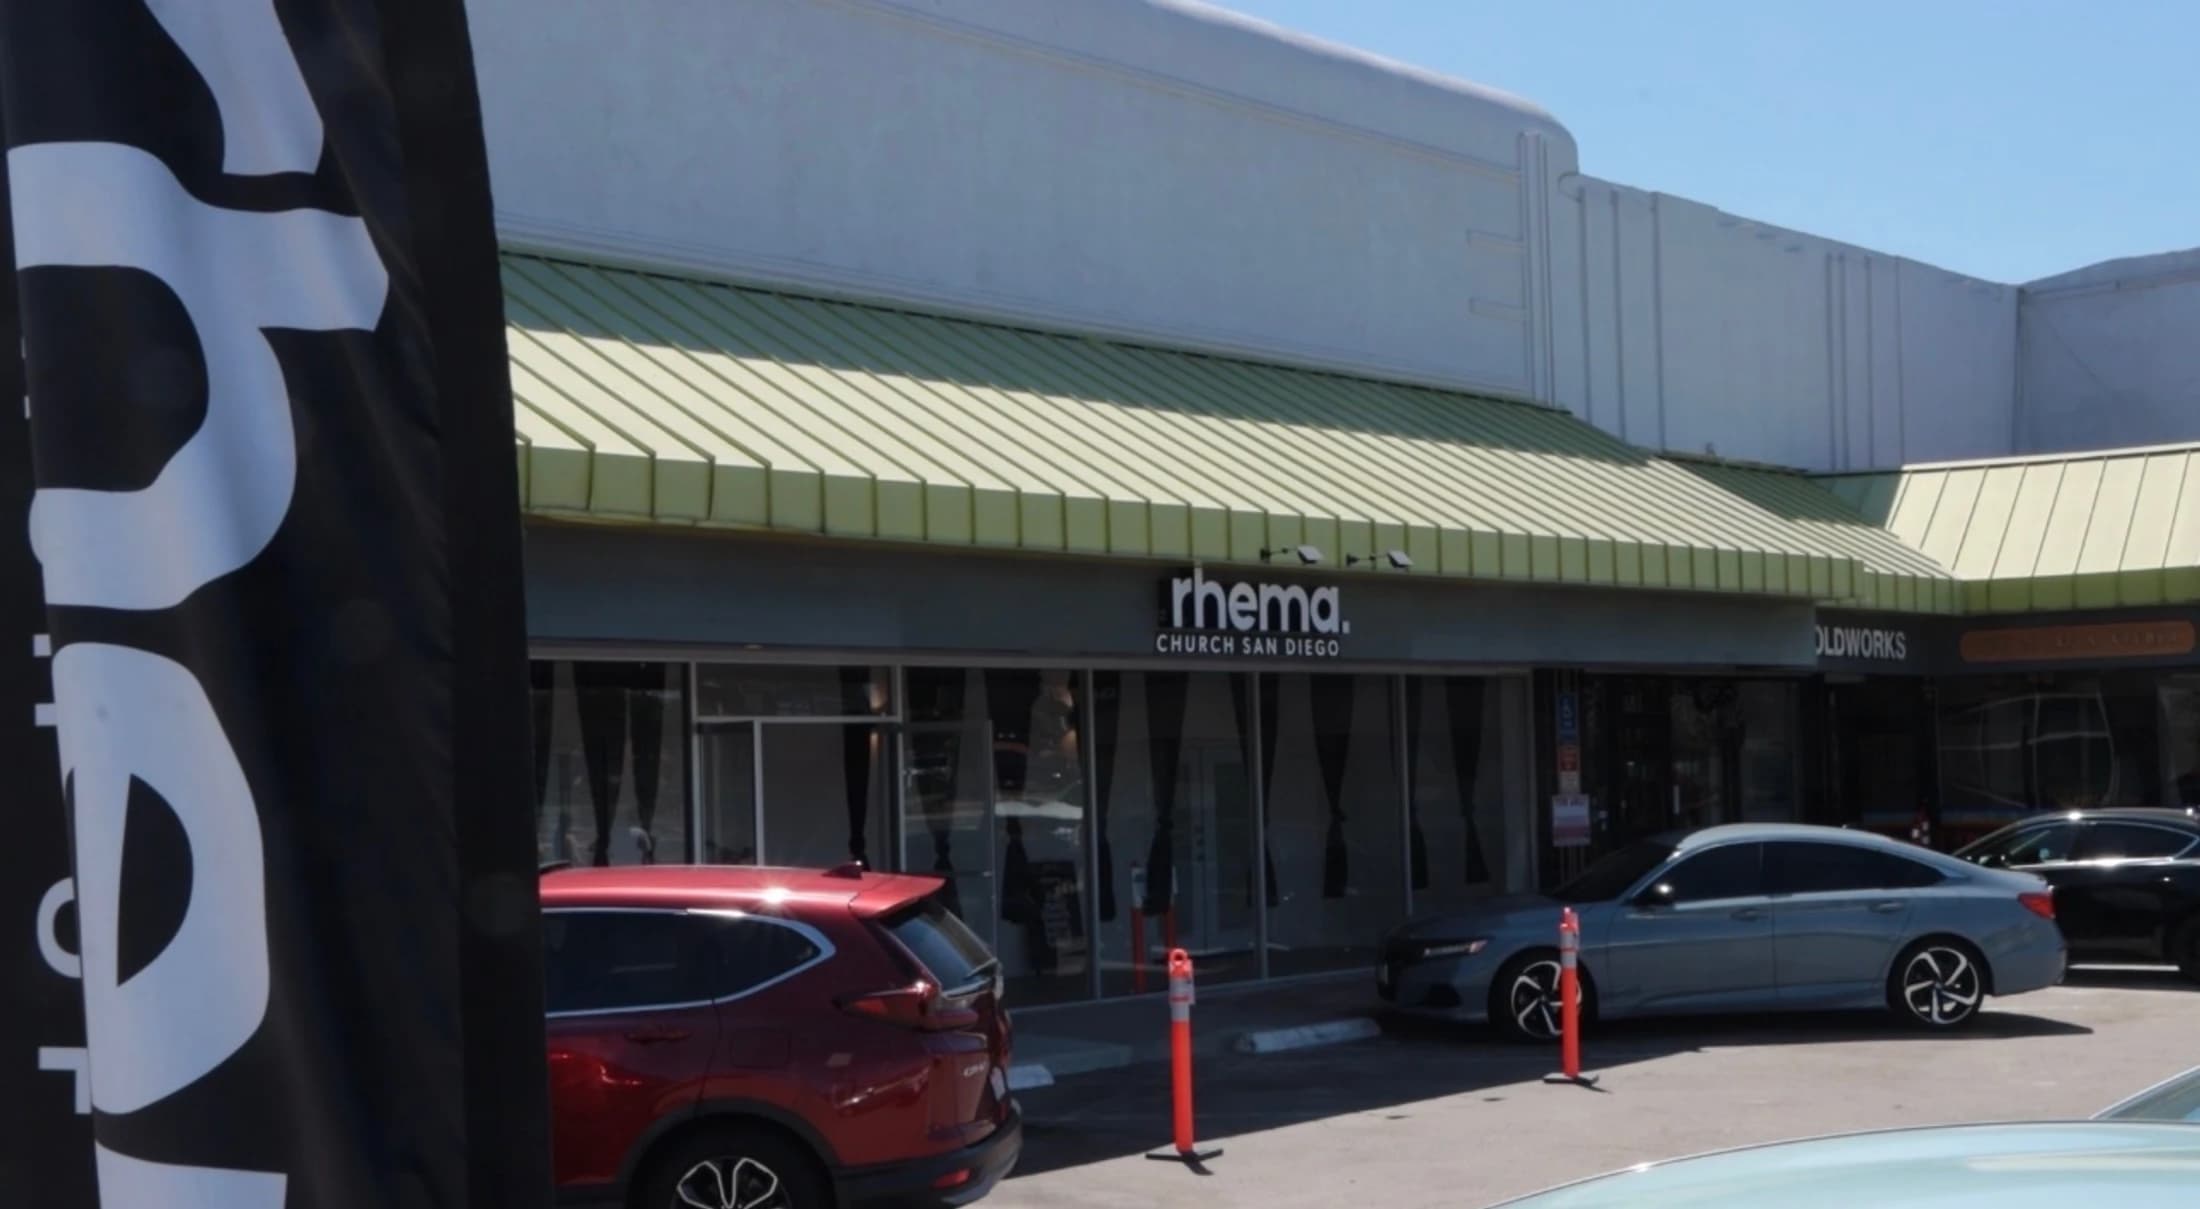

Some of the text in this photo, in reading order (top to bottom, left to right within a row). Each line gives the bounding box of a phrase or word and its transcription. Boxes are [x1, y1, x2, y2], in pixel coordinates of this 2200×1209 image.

[1171, 565, 1350, 635] rhema.
[1155, 634, 1340, 657] CHURCH SAN DIEGO
